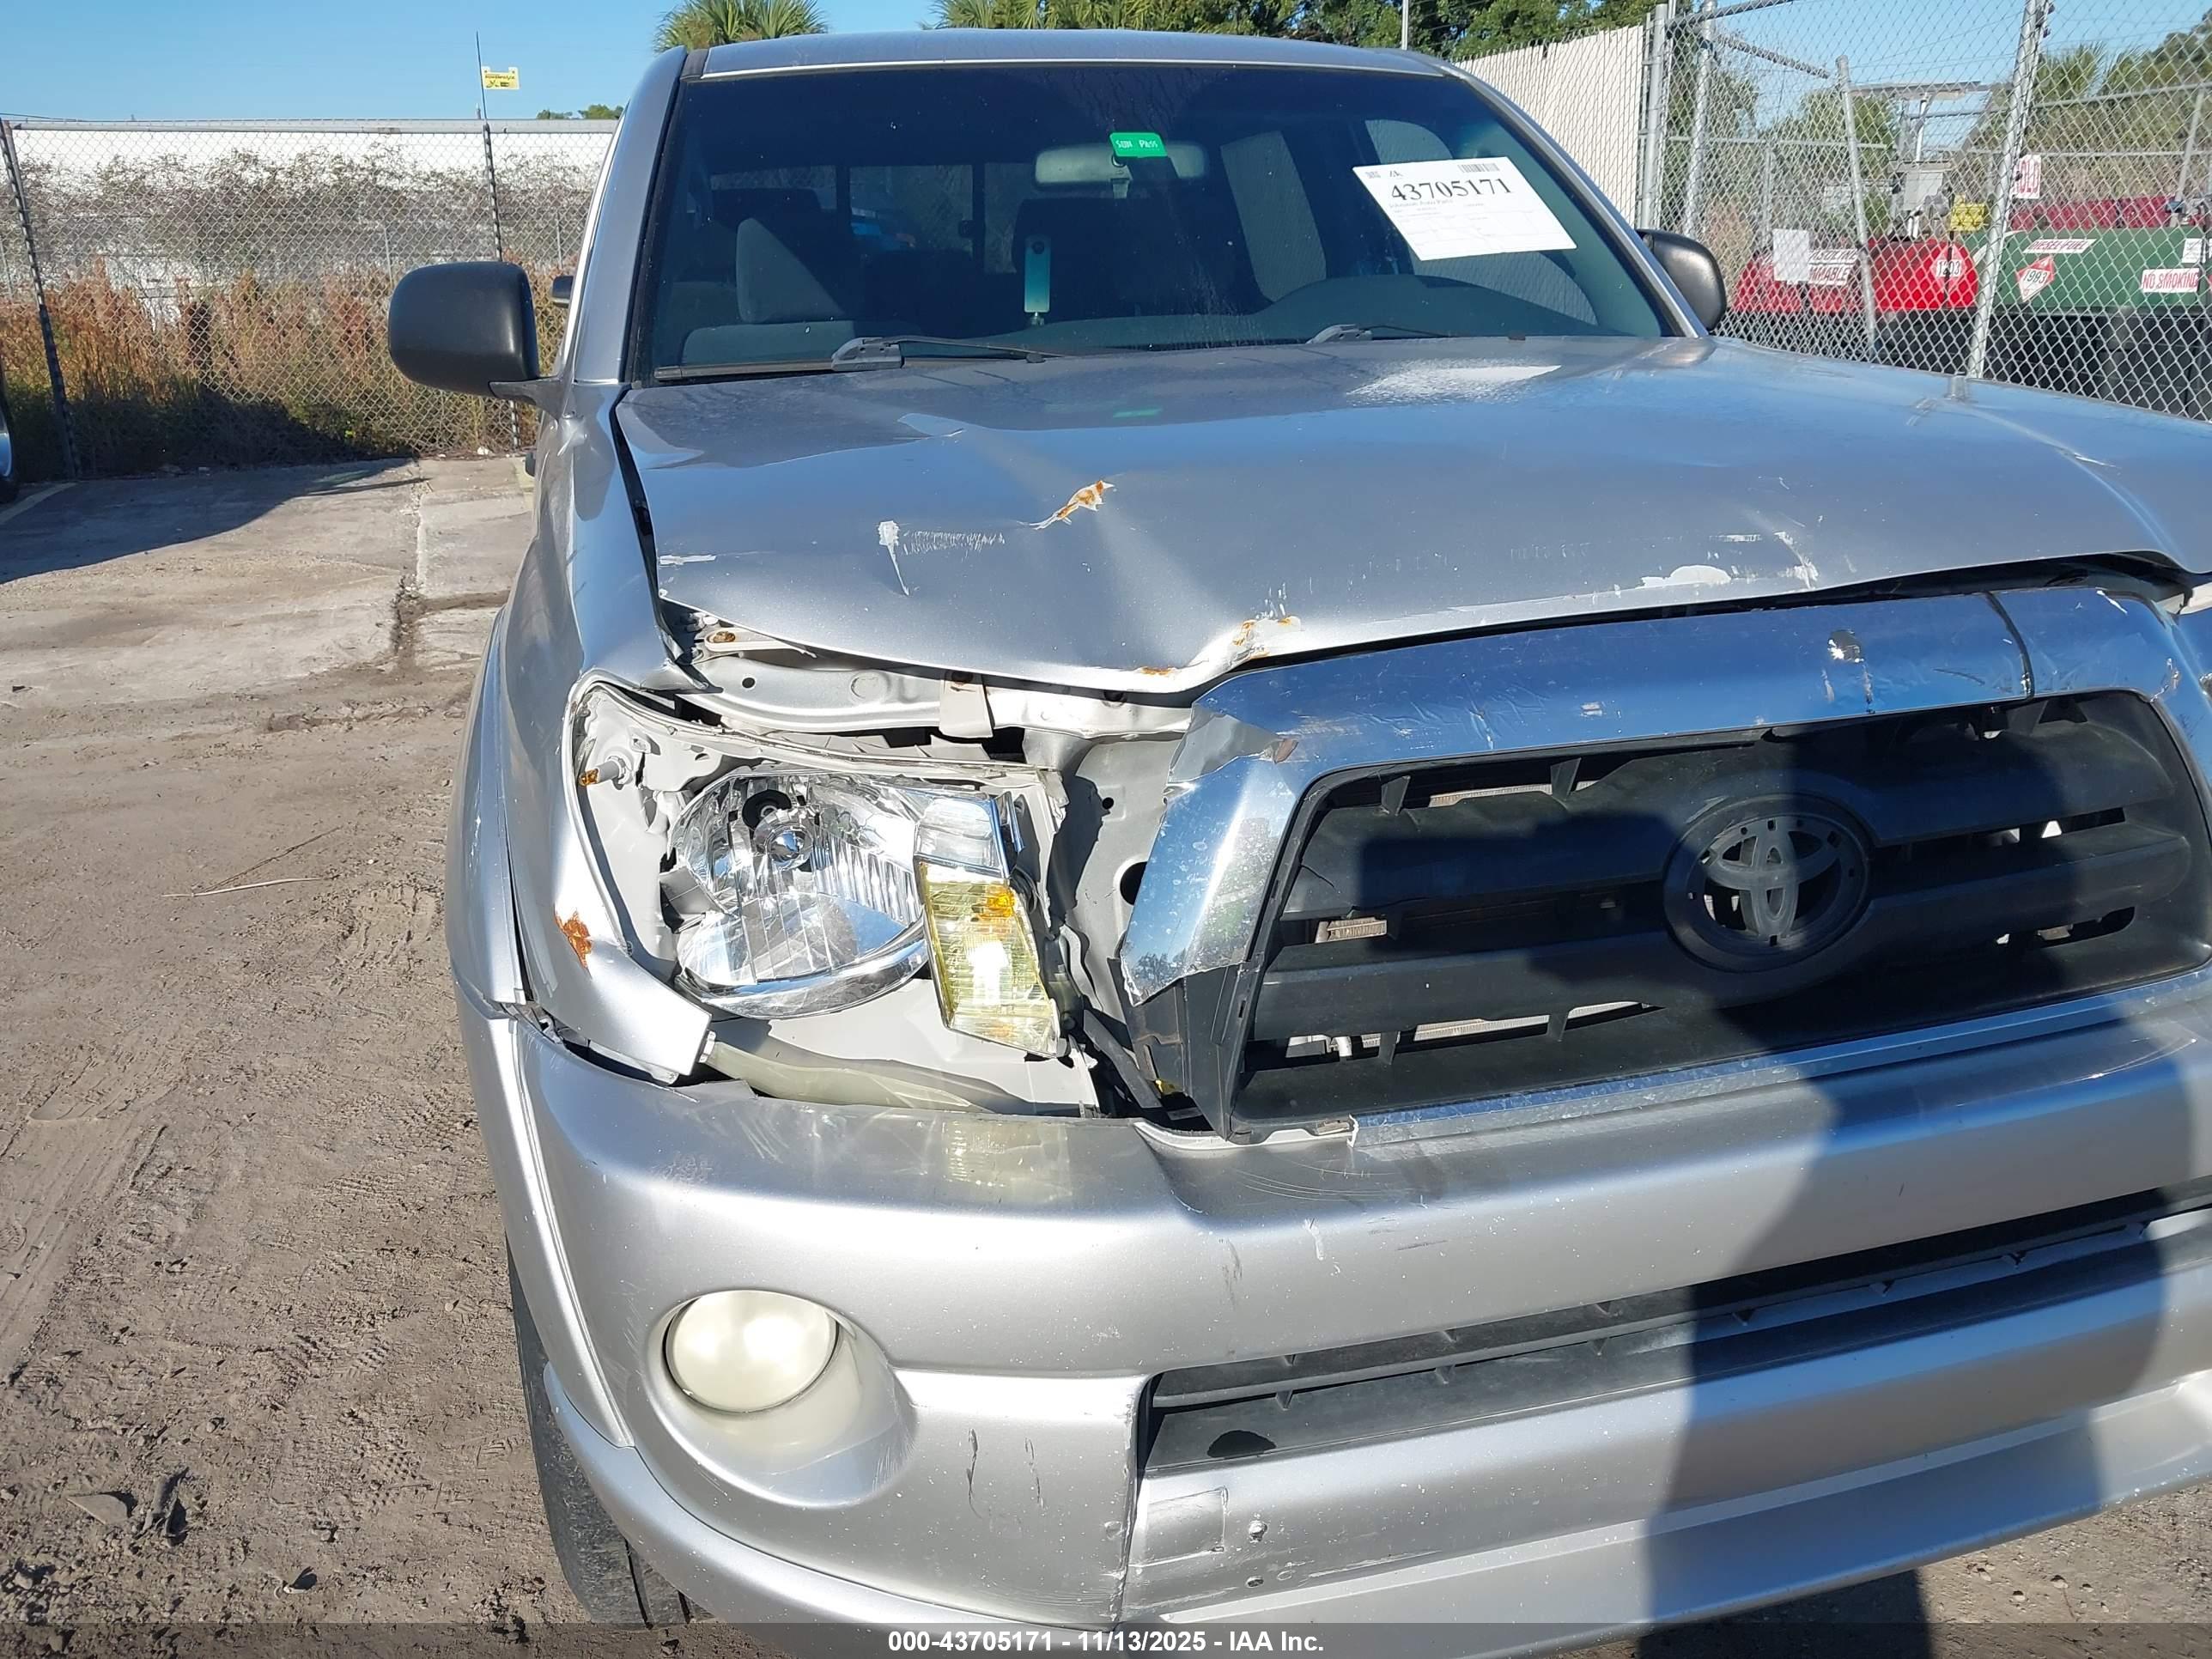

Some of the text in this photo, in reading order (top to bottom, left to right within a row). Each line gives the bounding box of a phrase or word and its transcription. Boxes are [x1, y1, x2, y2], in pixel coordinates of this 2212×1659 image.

[2013, 159, 2040, 193] OLD
[1391, 178, 1512, 201] 43705171
[2027, 240, 2089, 250] DIESEL FUEL
[1808, 249, 1856, 260] ASOLINE
[2023, 270, 2047, 283] 1993
[2143, 272, 2198, 289] NO SMOKING
